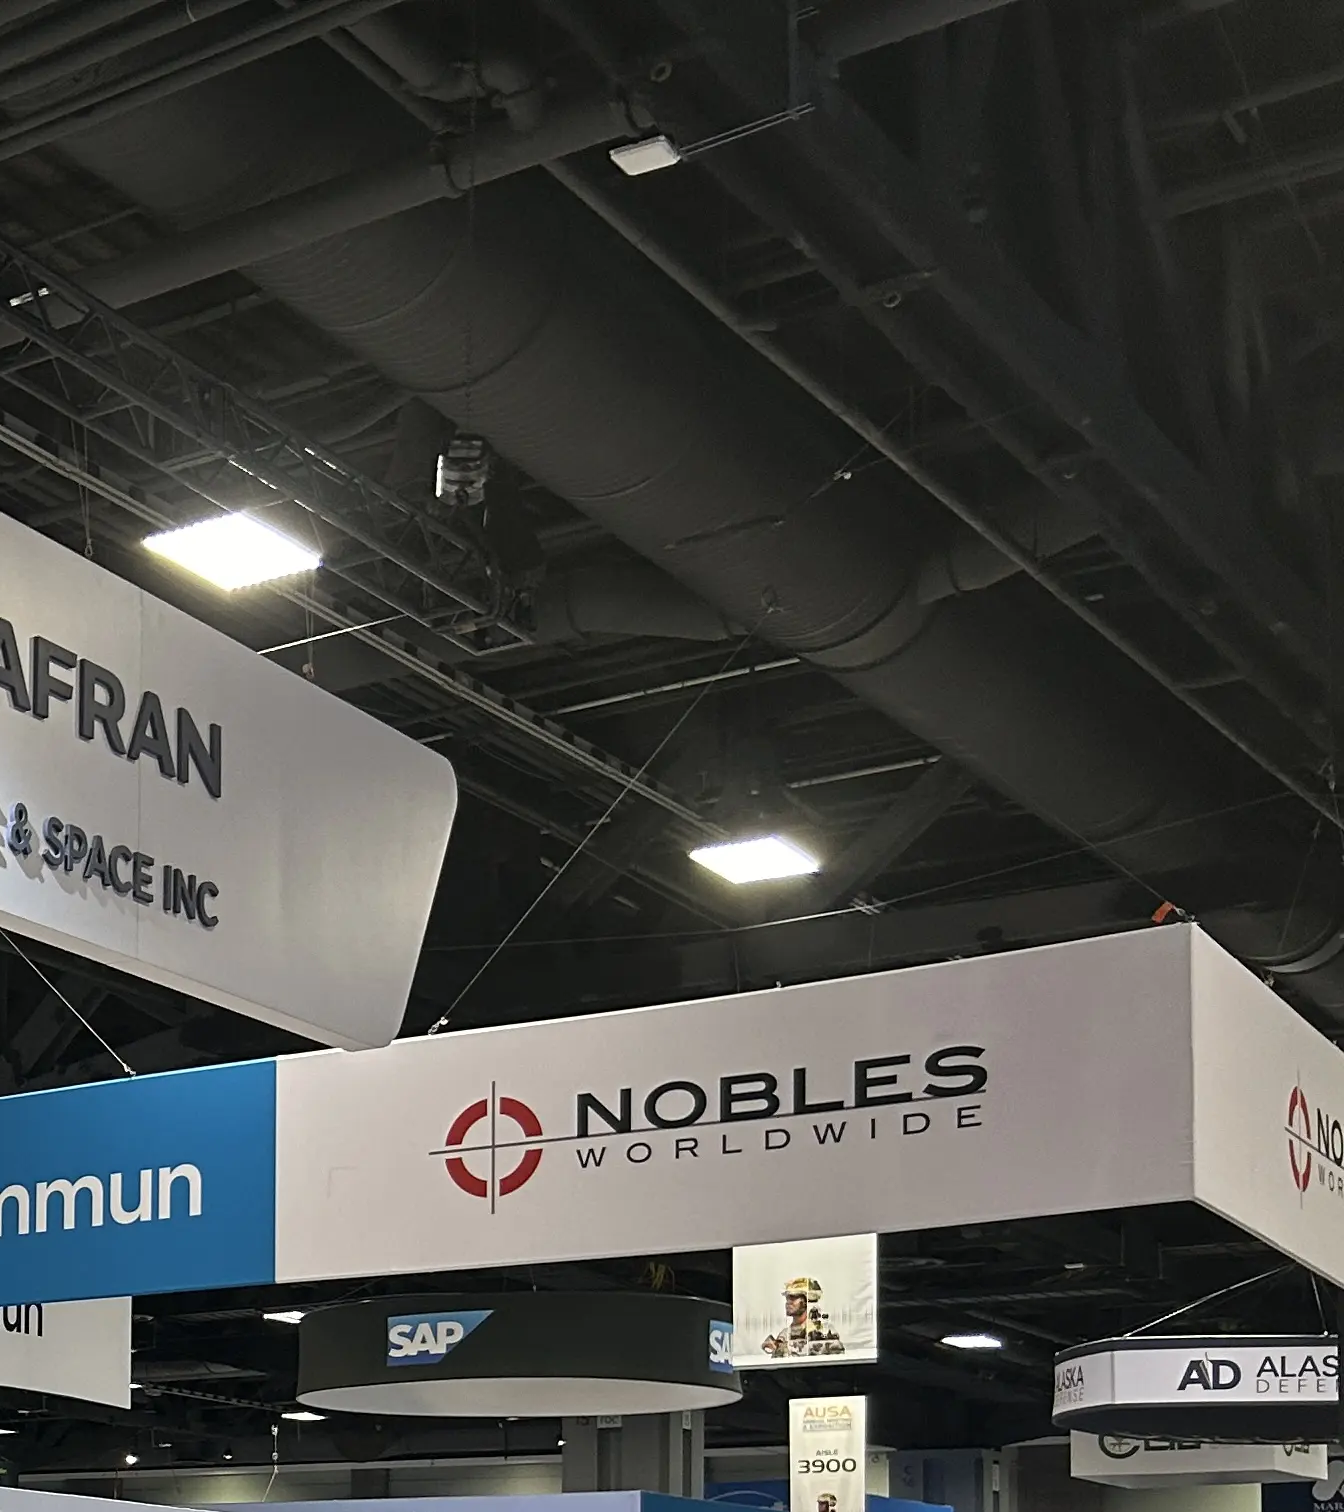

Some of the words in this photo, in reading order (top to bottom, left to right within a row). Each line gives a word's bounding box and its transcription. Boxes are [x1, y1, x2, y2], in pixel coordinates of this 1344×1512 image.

[8, 802, 32, 857] &
[43, 816, 154, 905] SPACE
[163, 864, 219, 928] INC
[576, 1045, 989, 1138] NOBLES
[576, 1105, 985, 1170] WORLDWIDE
[388, 1322, 464, 1357] SAP
[1256, 1378, 1339, 1394] DEFE
[803, 1406, 852, 1419] AUSA
[798, 1458, 857, 1474] 3900
